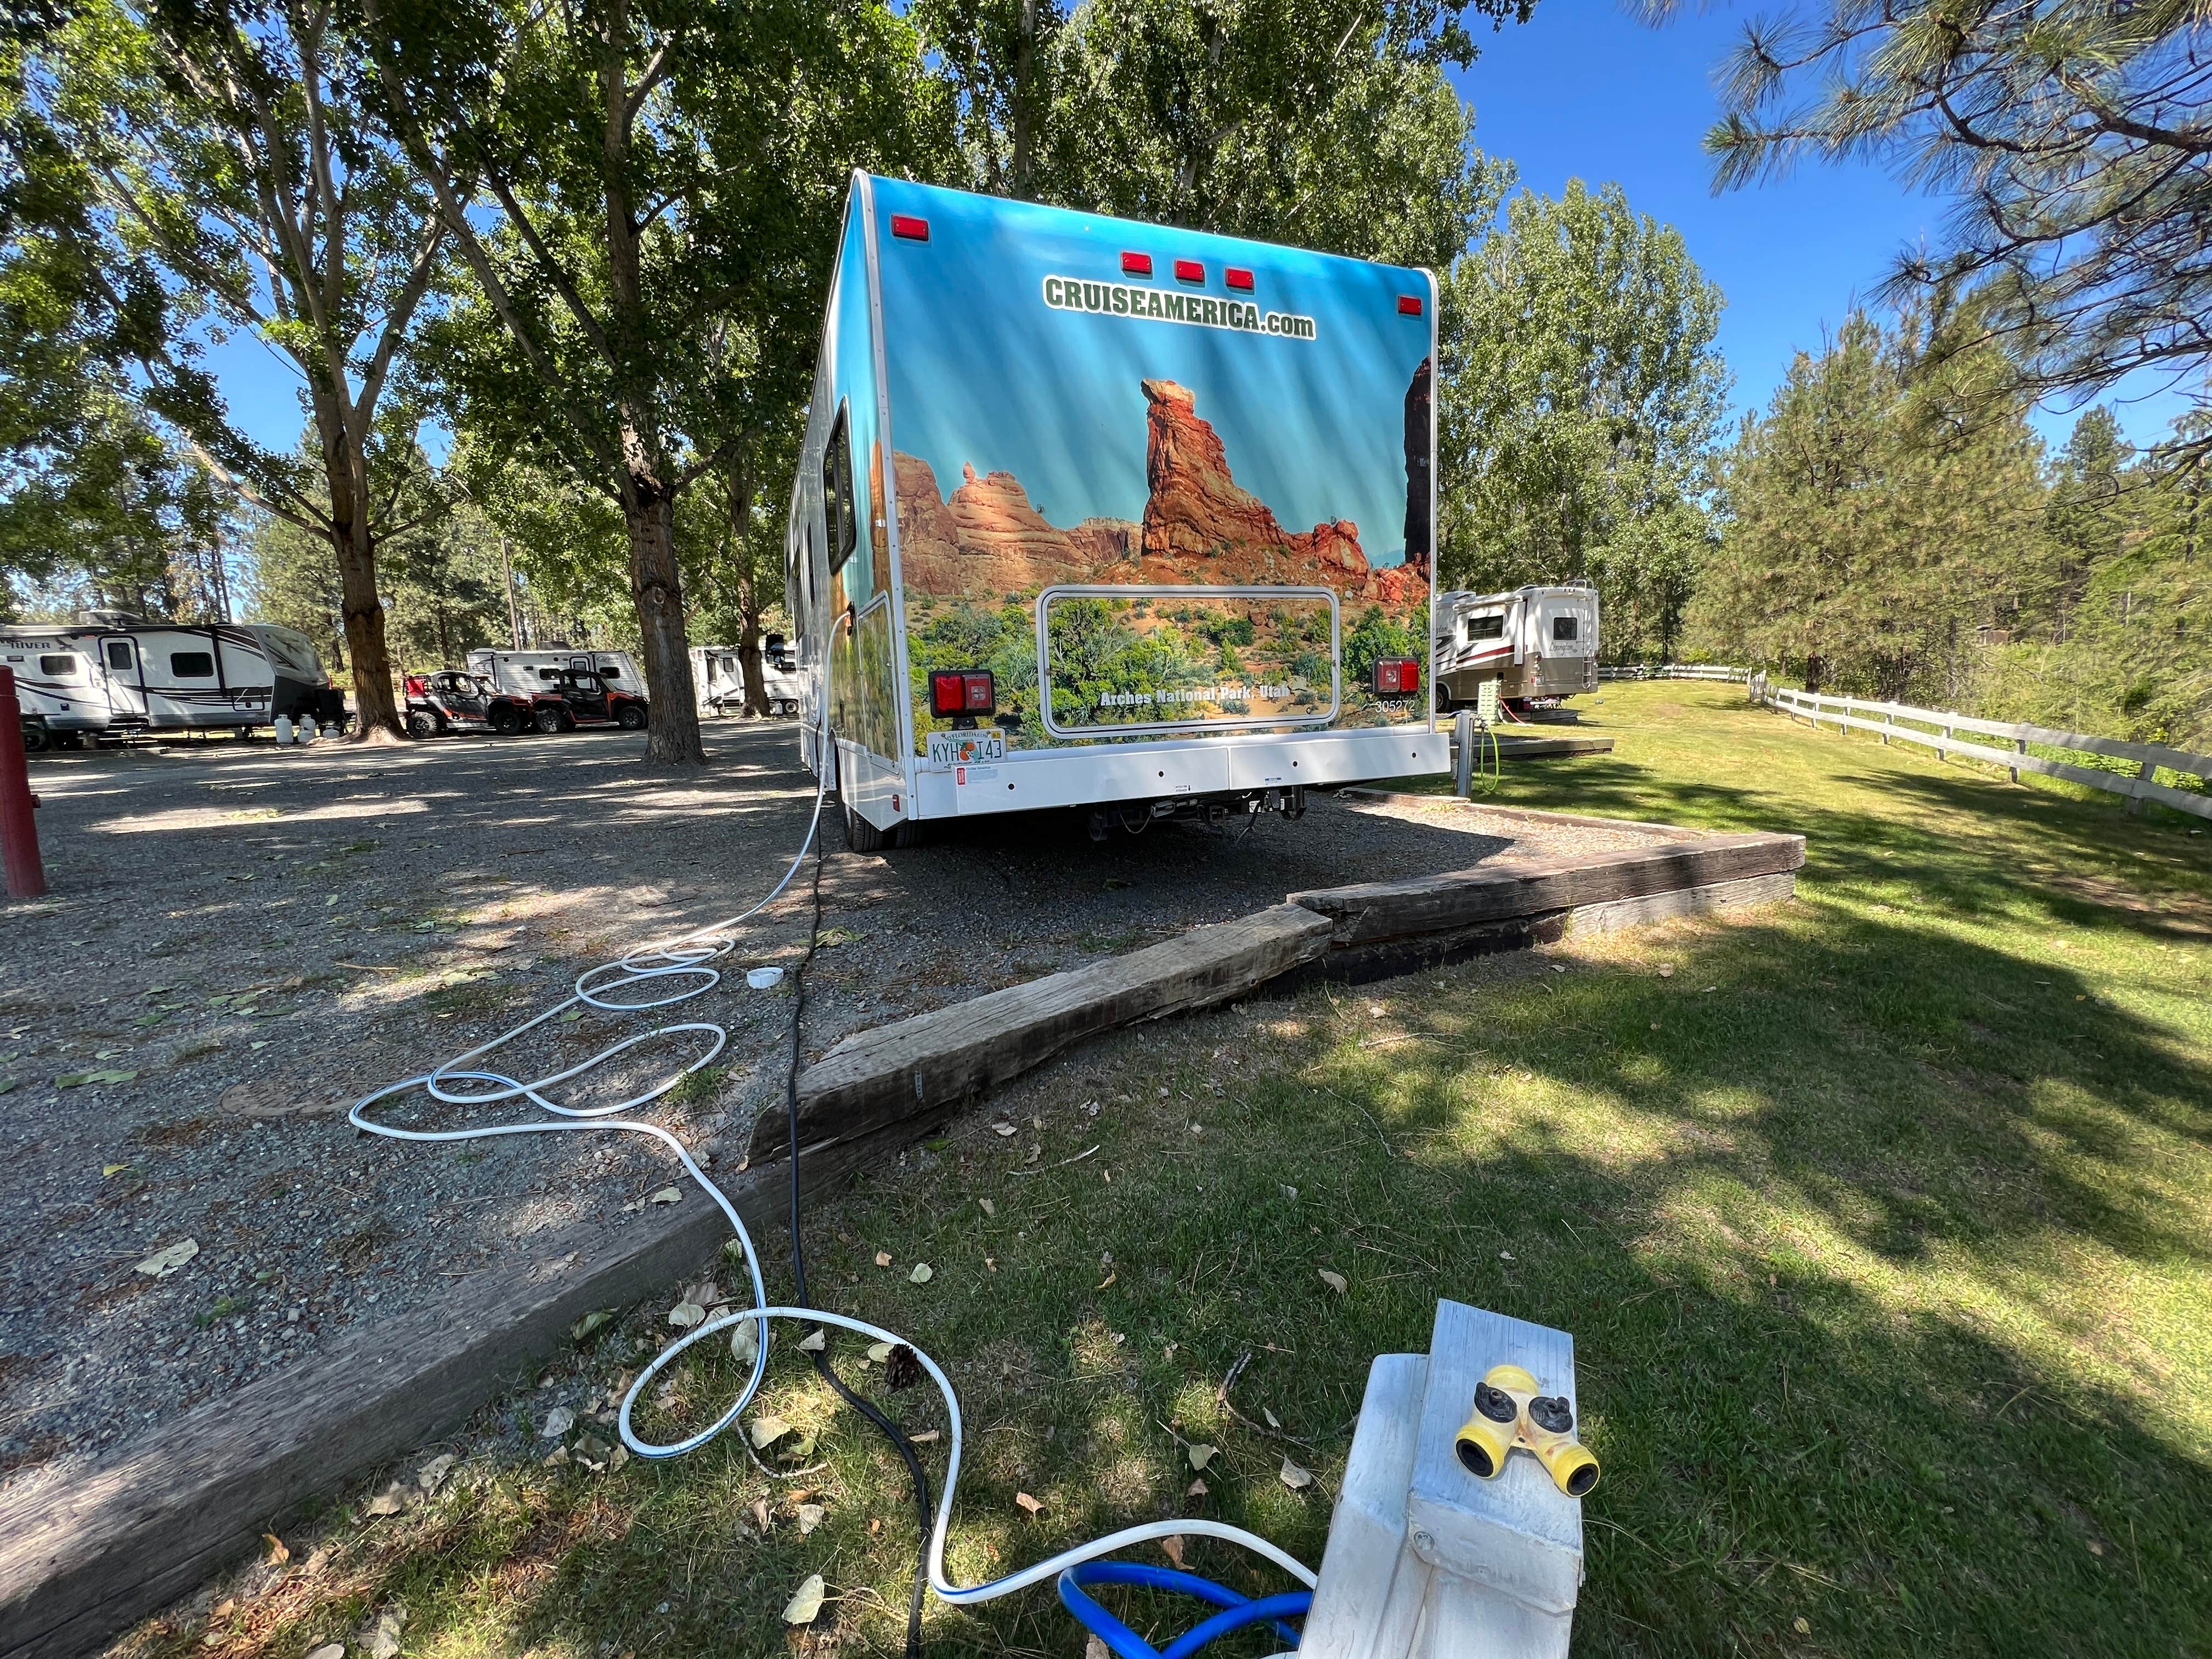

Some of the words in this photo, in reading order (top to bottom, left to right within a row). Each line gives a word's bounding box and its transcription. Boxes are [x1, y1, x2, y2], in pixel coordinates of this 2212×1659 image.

[1045, 278, 1315, 338] CRUISEAMERICA.com
[1101, 691, 1152, 706] Arches
[1156, 687, 1216, 703] National
[1220, 686, 1255, 700] Park,
[1259, 685, 1290, 698] Utah
[1375, 700, 1415, 713] 305272
[932, 742, 960, 763] KYH
